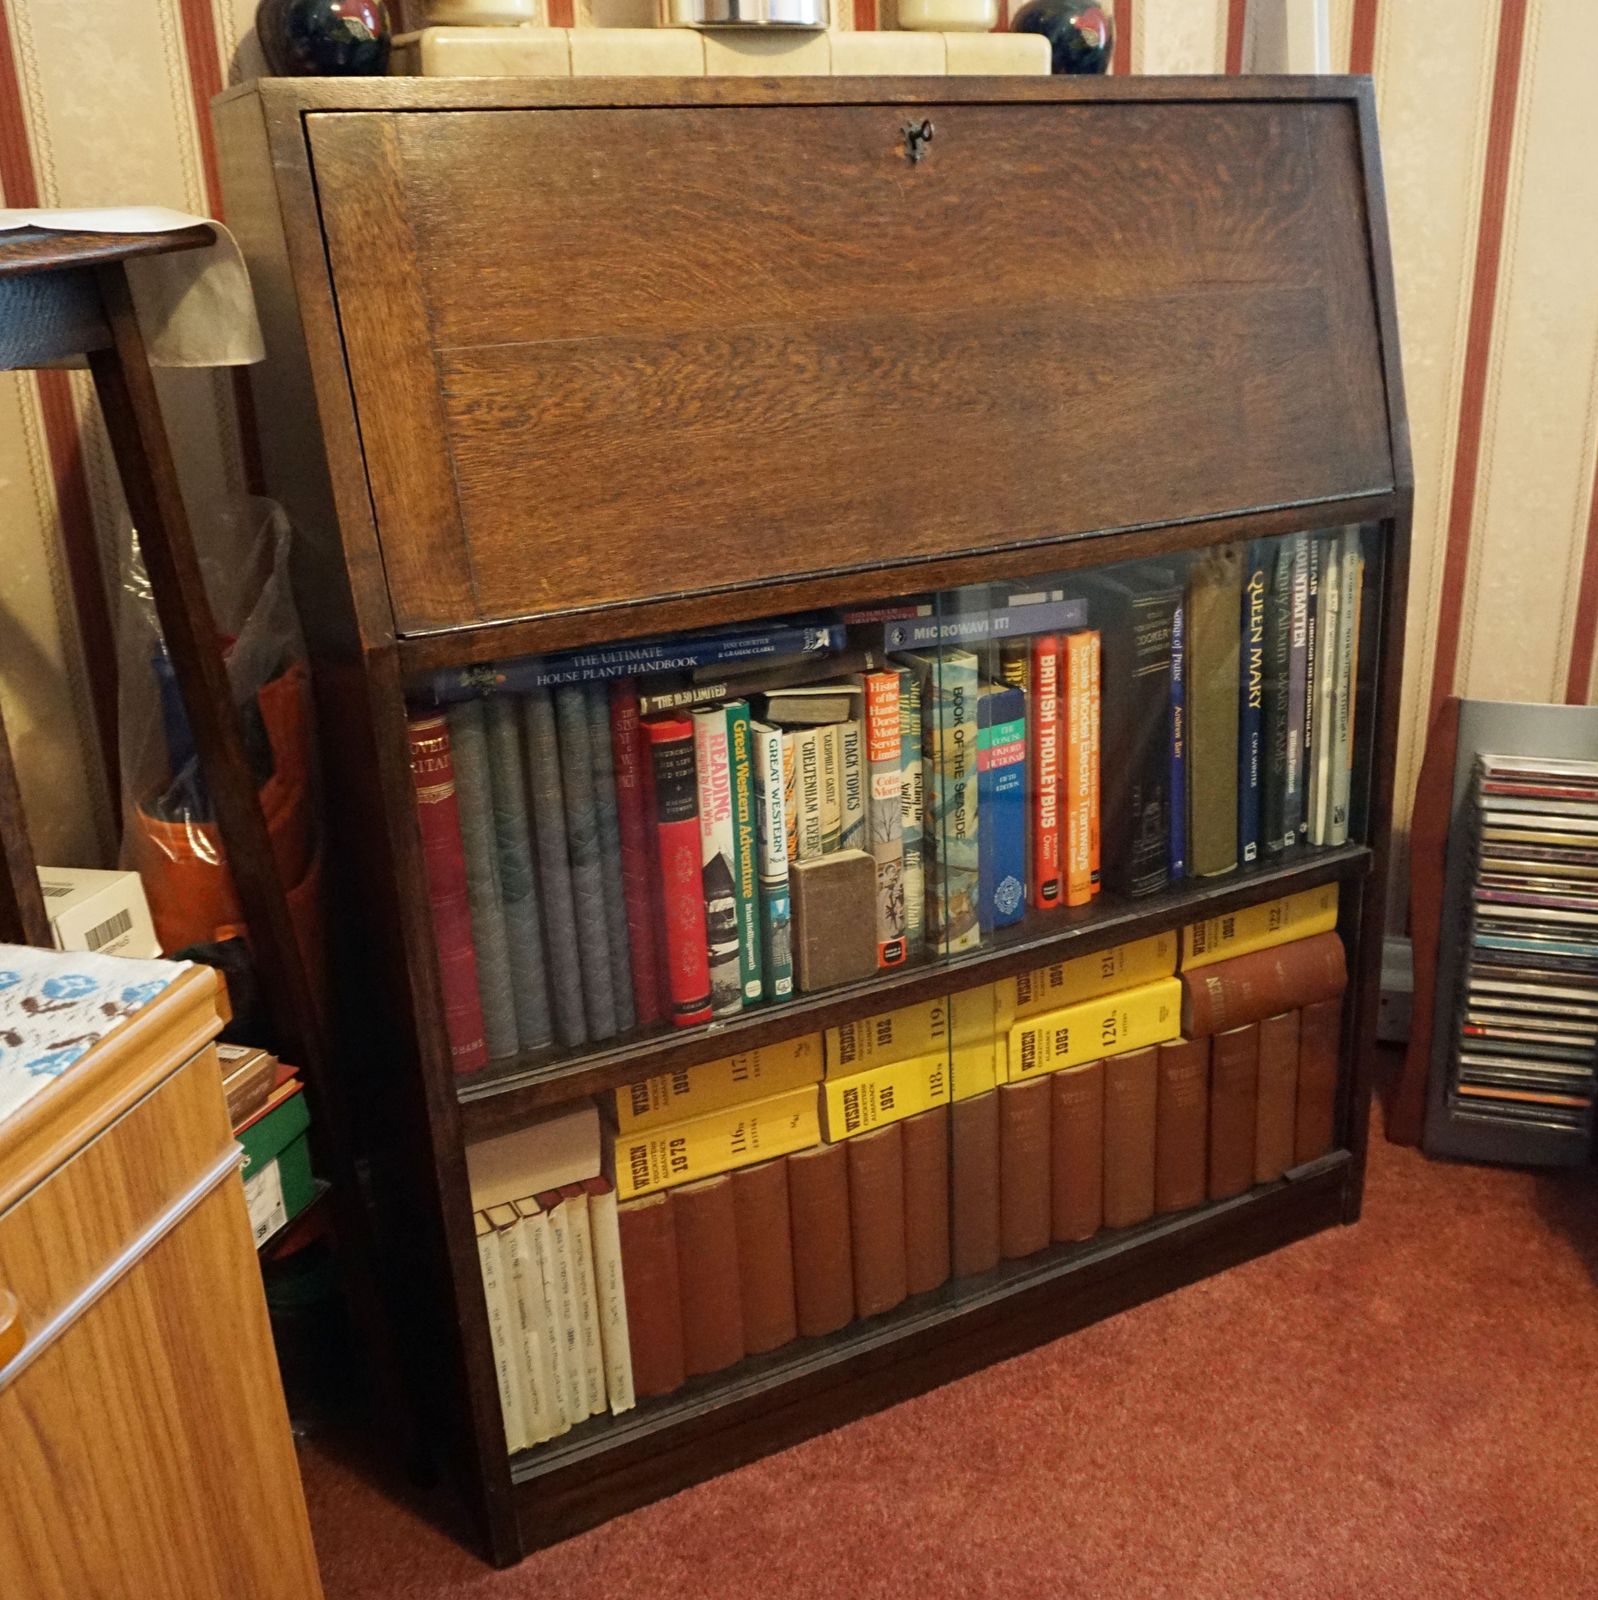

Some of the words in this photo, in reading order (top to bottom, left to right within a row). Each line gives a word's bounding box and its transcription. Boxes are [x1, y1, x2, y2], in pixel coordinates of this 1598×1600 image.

[1275, 551, 1291, 605] Family
[1293, 539, 1309, 648] MOUNTBATTEN
[1247, 570, 1265, 643] QUEEN
[1275, 606, 1291, 665] Album
[1307, 617, 1315, 660] THROUGH
[537, 671, 579, 686] HOUSE
[583, 665, 625, 680] PLANT
[627, 656, 698, 674] HANDBOOK
[572, 654, 599, 667] THE
[601, 646, 663, 665] ULTIMATE
[1080, 645, 1091, 690] Scale
[1171, 653, 1184, 682] Praise
[876, 693, 886, 703] of
[1040, 654, 1057, 722] BRITISH
[1248, 647, 1265, 709] MARY
[1305, 680, 1313, 714] LOOKING
[953, 687, 964, 728] BOOK
[1080, 691, 1091, 743] Model
[1173, 705, 1184, 740] Andrew
[733, 720, 749, 761] Great
[844, 730, 858, 770] TRACK
[953, 730, 964, 745] OF
[1173, 741, 1184, 759] Barr
[1288, 729, 1299, 758] William
[1304, 715, 1312, 748] GLASS
[709, 731, 731, 822] READING
[768, 738, 780, 782] GREAT
[953, 751, 965, 780] THE
[1040, 725, 1058, 829] TROLLEYBUS
[1079, 745, 1091, 797] Electric
[702, 789, 713, 810] Alan
[735, 762, 751, 822] Western
[845, 773, 861, 812] TOPICS
[954, 783, 966, 841] SEASIDE
[703, 810, 714, 837] Wykes
[770, 789, 783, 853] WESTERN
[1078, 800, 1090, 870] Tramways
[740, 825, 753, 899] Adventure
[1043, 836, 1051, 860] Owen
[745, 903, 754, 922] Brian
[746, 924, 757, 970] Hollingsworth
[1021, 1031, 1036, 1072] WISDEN
[1055, 1028, 1070, 1056] 1983
[630, 1081, 650, 1117] WISD
[843, 1087, 861, 1133] WISDEN
[879, 1086, 895, 1112] 1981
[630, 1144, 650, 1191] WISDEN
[669, 1137, 689, 1174] 1979
